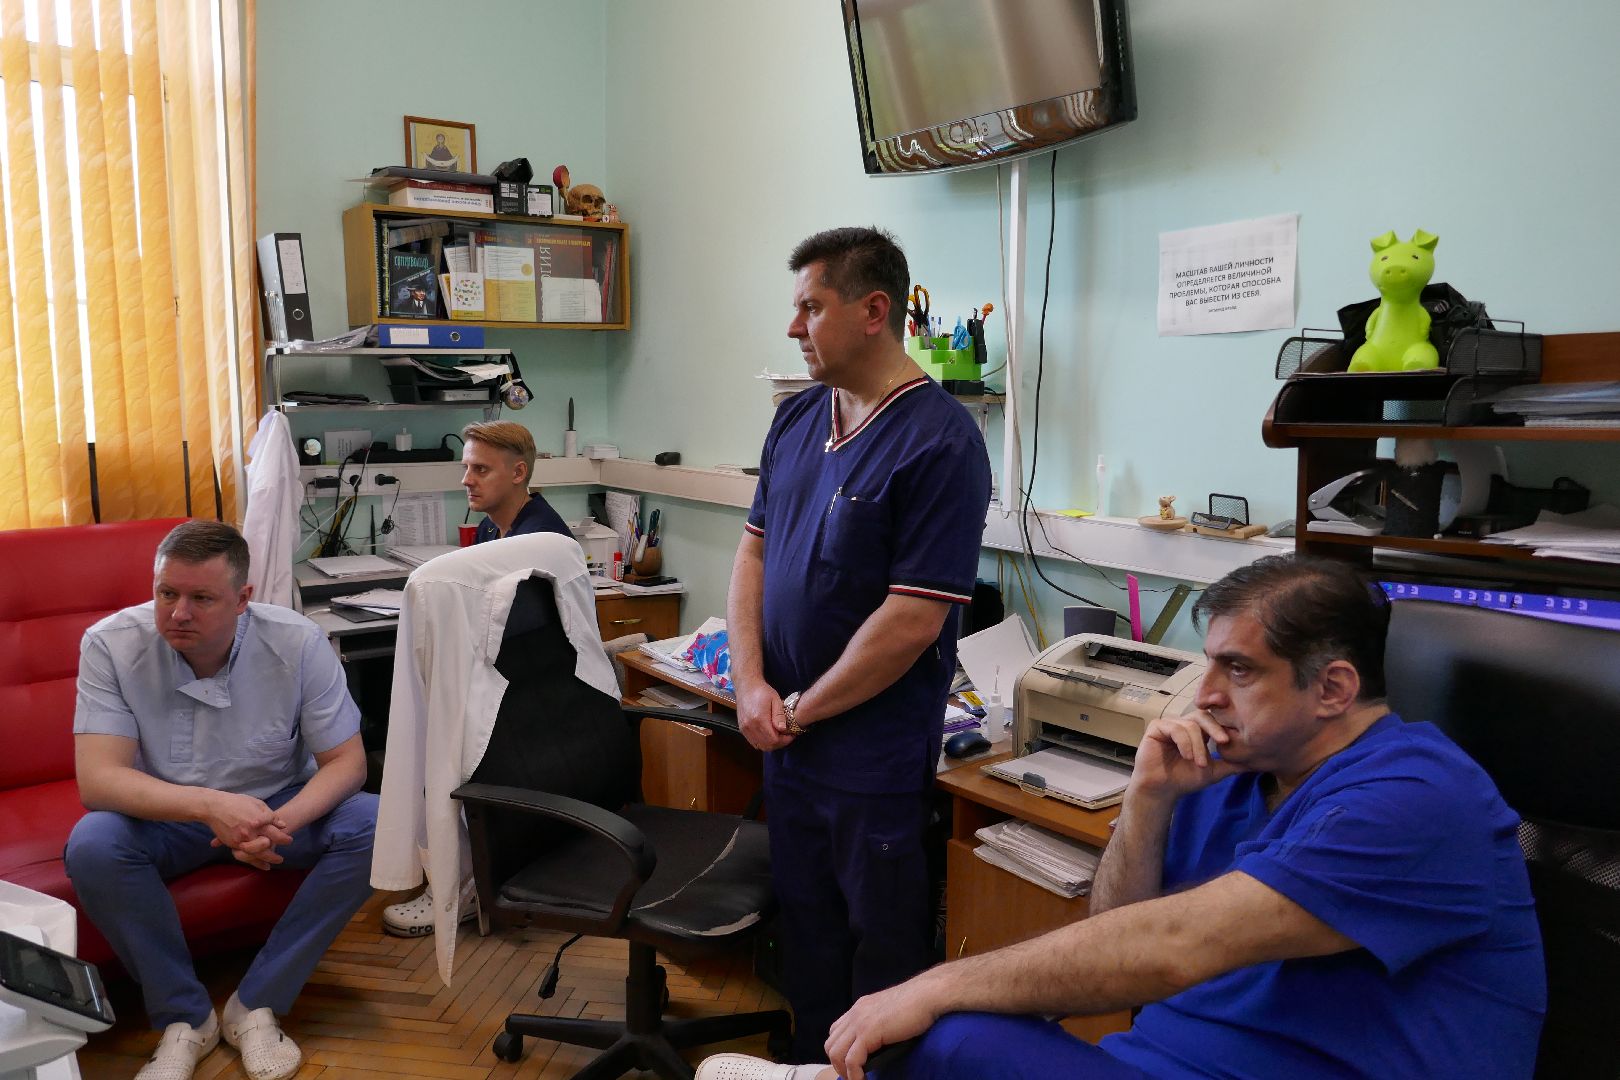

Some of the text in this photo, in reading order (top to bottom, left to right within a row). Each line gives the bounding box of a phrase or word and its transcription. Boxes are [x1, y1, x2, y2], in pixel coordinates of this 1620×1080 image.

[1176, 256, 1274, 278] МАСШТАБ ВАШЕЙ ЛИЧНОСТИ
[1177, 267, 1272, 288] ОПРЕДЕЛЯЕТСЯ ВЕЛИЧИНОЙ
[1169, 276, 1281, 299] ПРОБЛЕМЫ, КОТОРАЯ СПОСОБНА
[1185, 289, 1262, 306] ВАС ВЫВЕСТИ ИЗ СЕБЯ.
[409, 925, 433, 934] cro
